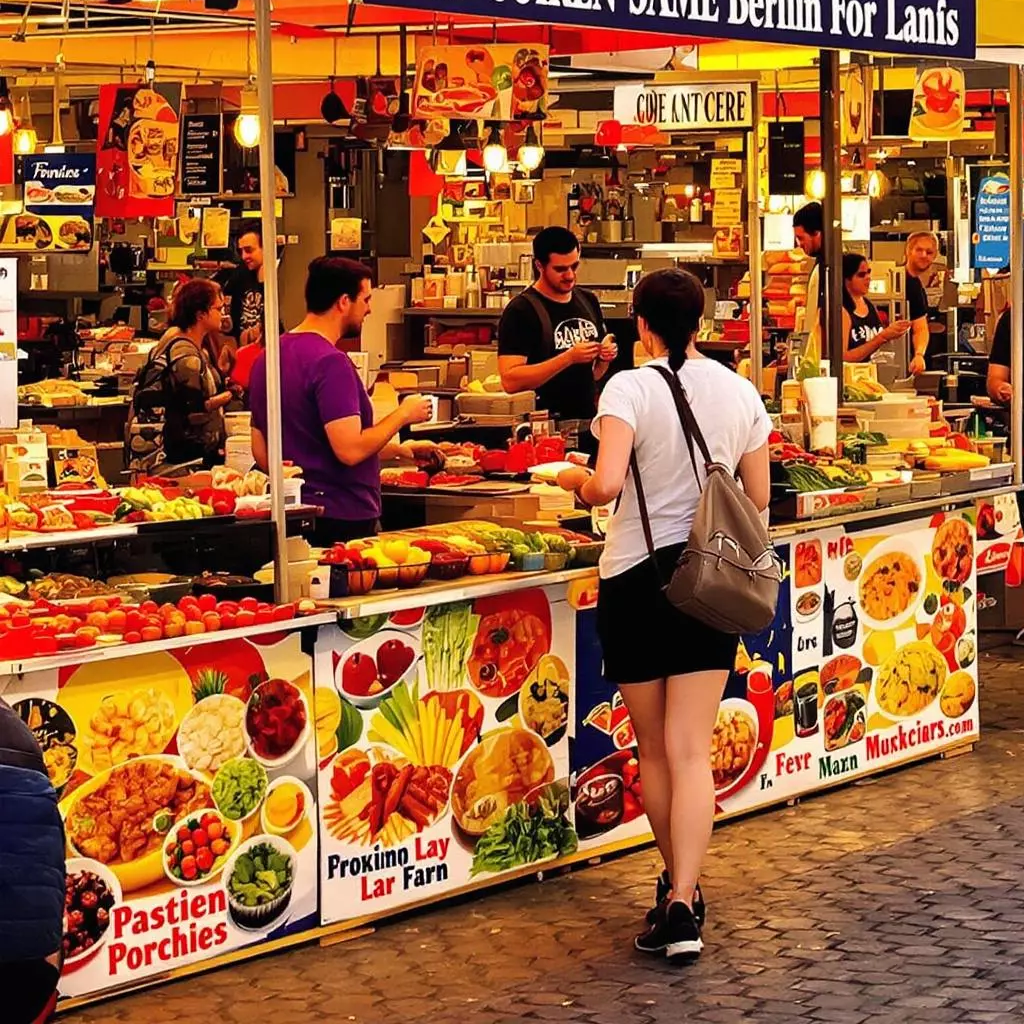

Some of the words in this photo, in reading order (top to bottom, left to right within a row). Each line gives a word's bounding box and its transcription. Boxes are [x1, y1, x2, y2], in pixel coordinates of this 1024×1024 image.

[415, 837, 450, 861] Lay
[361, 876, 395, 901] Lar
[112, 889, 226, 939] Pastien
[108, 922, 227, 976] Porchies
